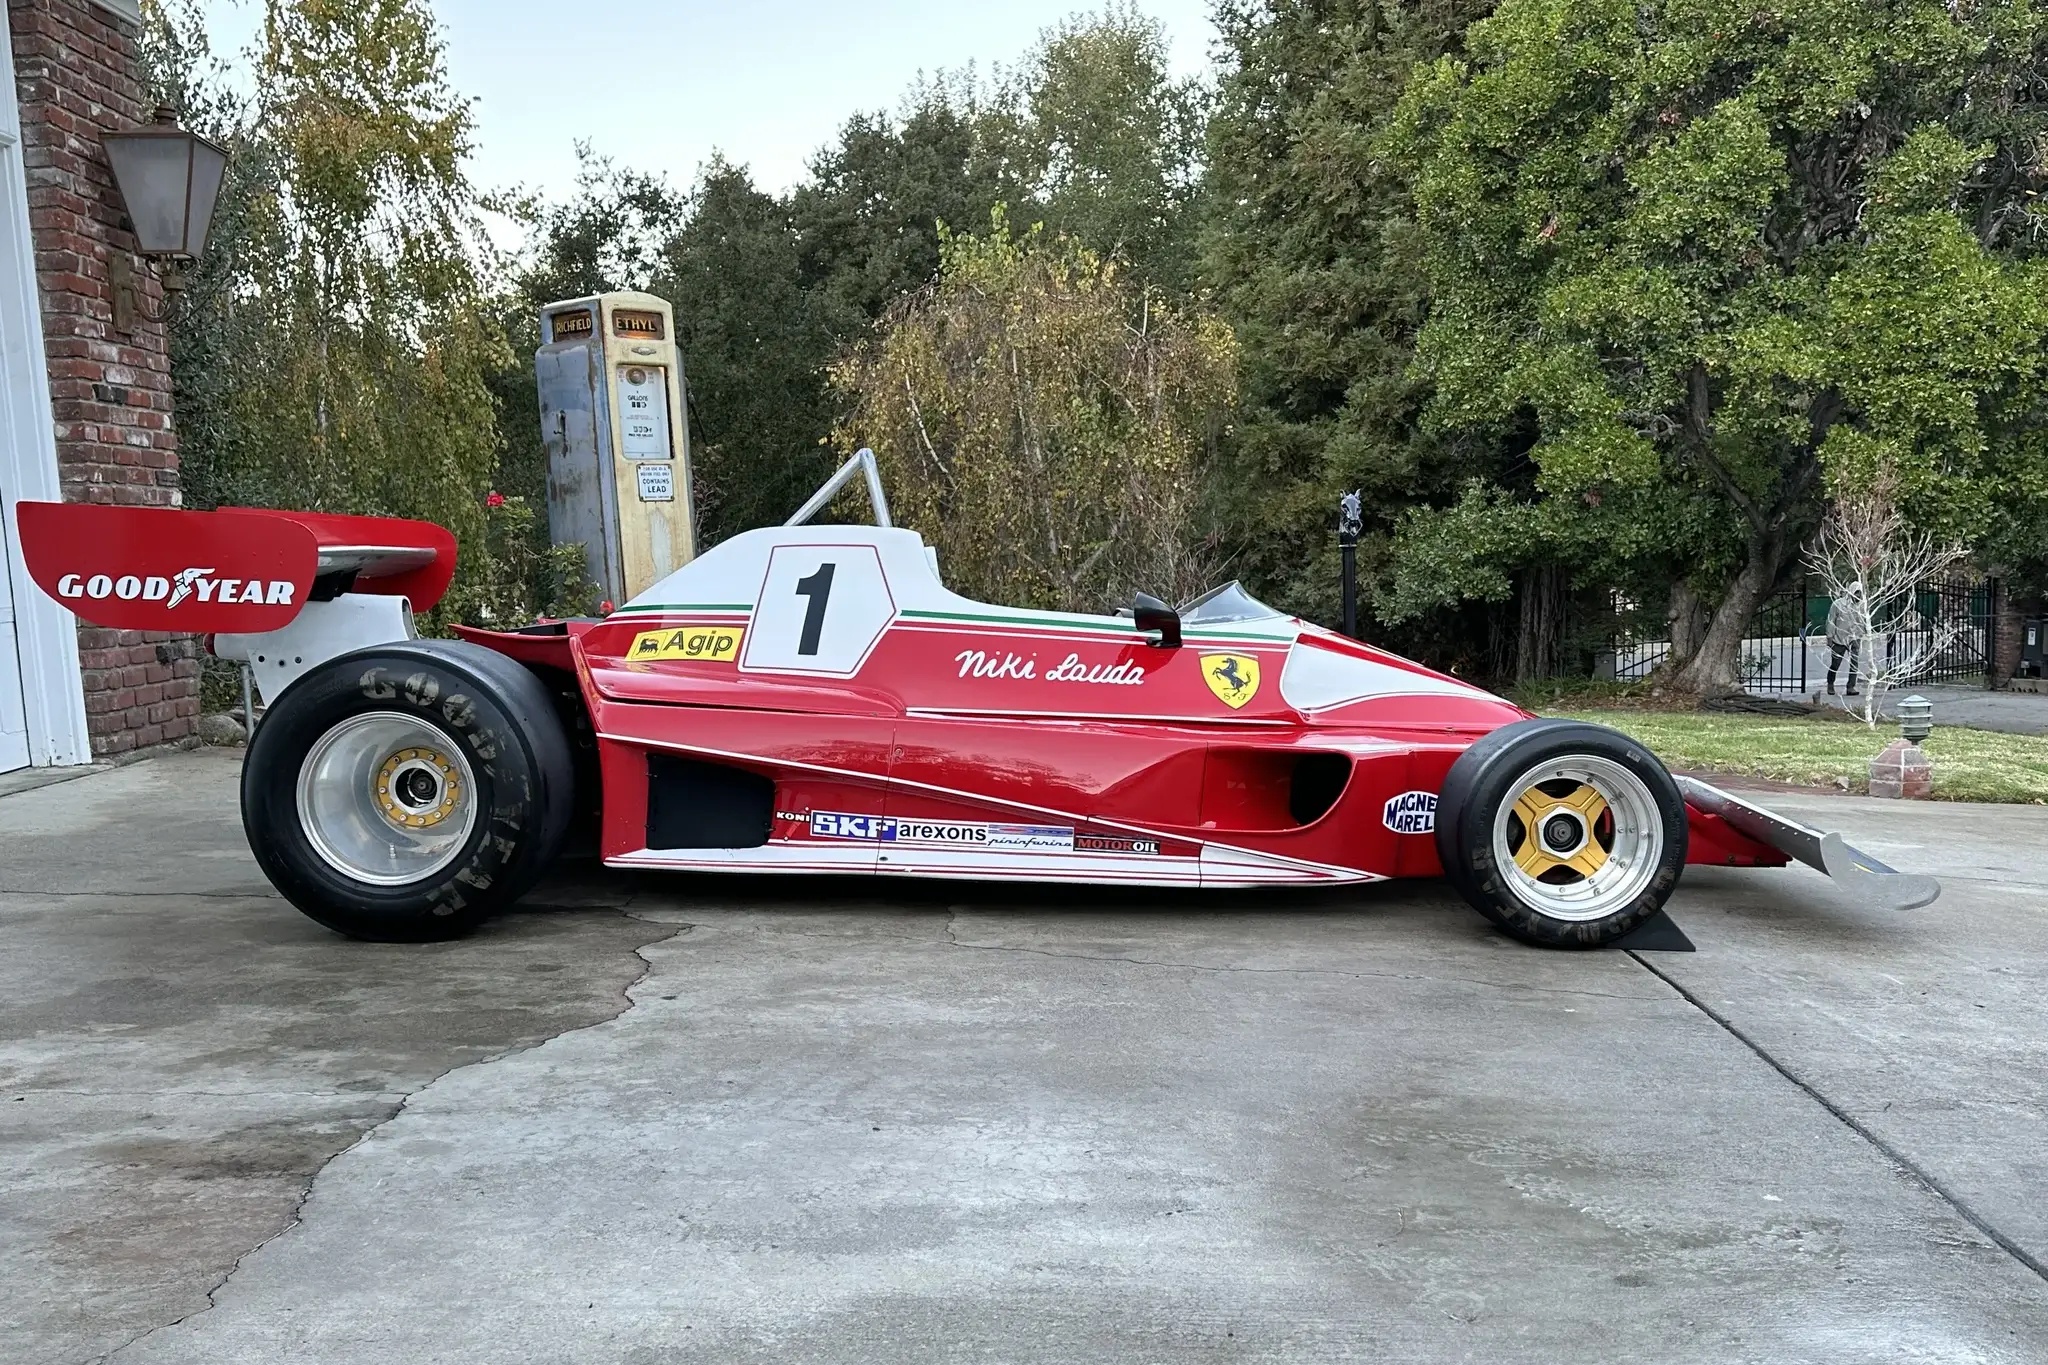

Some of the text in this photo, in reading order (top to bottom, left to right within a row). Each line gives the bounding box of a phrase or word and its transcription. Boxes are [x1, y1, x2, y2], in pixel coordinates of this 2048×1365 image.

[556, 318, 592, 333] RICHFIELD
[616, 317, 656, 331] ETHYL
[647, 485, 667, 493] LEAD
[795, 563, 836, 655] 1
[663, 630, 734, 656] Agip
[955, 650, 1145, 685] Niki Lauda
[776, 811, 810, 822] KONI
[813, 814, 896, 838] SKF
[899, 823, 987, 841] arexons
[988, 837, 1072, 848] pininfarina
